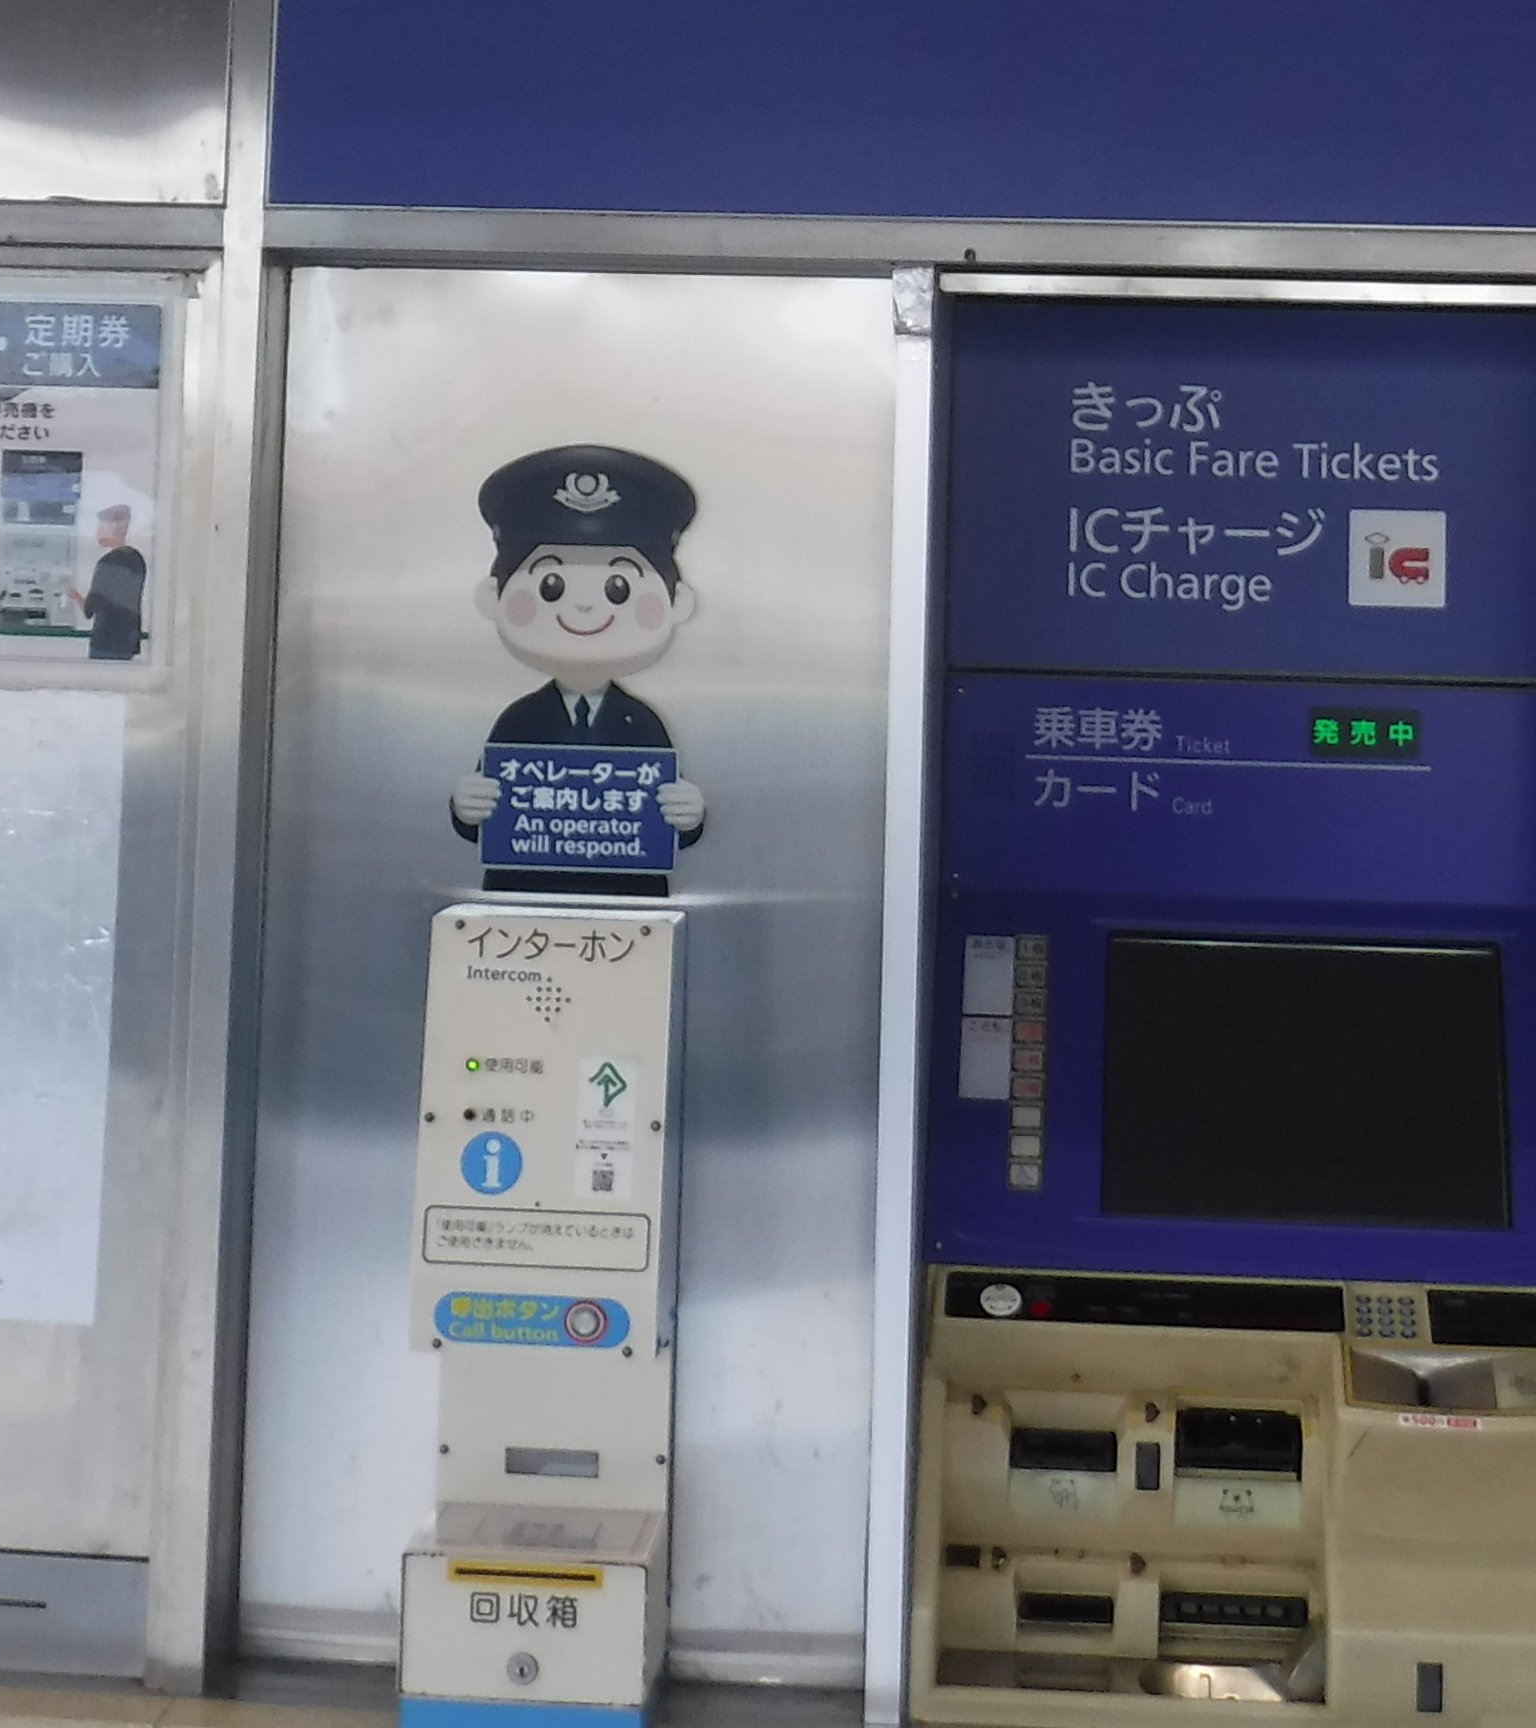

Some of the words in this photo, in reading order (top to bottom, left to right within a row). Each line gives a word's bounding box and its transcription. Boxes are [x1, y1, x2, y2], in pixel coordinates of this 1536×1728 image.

[24, 314, 131, 349] 定期券
[23, 352, 102, 377] ご購入
[1070, 382, 1223, 432] きっぷ
[1070, 438, 1173, 476] Basic
[1189, 442, 1279, 480] Fare
[1293, 443, 1440, 482] Tickets
[1069, 507, 1325, 556] ICチャージ
[1067, 564, 1106, 598] IC
[1120, 564, 1272, 610] Charge
[1033, 707, 1162, 750] 乗車券
[1176, 736, 1230, 754] Ticket
[1313, 719, 1414, 746] 発売中
[499, 759, 659, 784] オペレーターが
[510, 786, 647, 811] ご案内します
[1034, 771, 1159, 810] カード
[1172, 798, 1213, 815] Card
[514, 815, 546, 831] An
[552, 817, 642, 837] operator
[511, 835, 549, 854] will
[555, 836, 646, 859] respond.
[468, 928, 634, 963] インターホン
[467, 966, 541, 982] Intercom
[449, 1322, 486, 1338] Call
[492, 1324, 559, 1342] button
[470, 1592, 579, 1629] 回収箱
